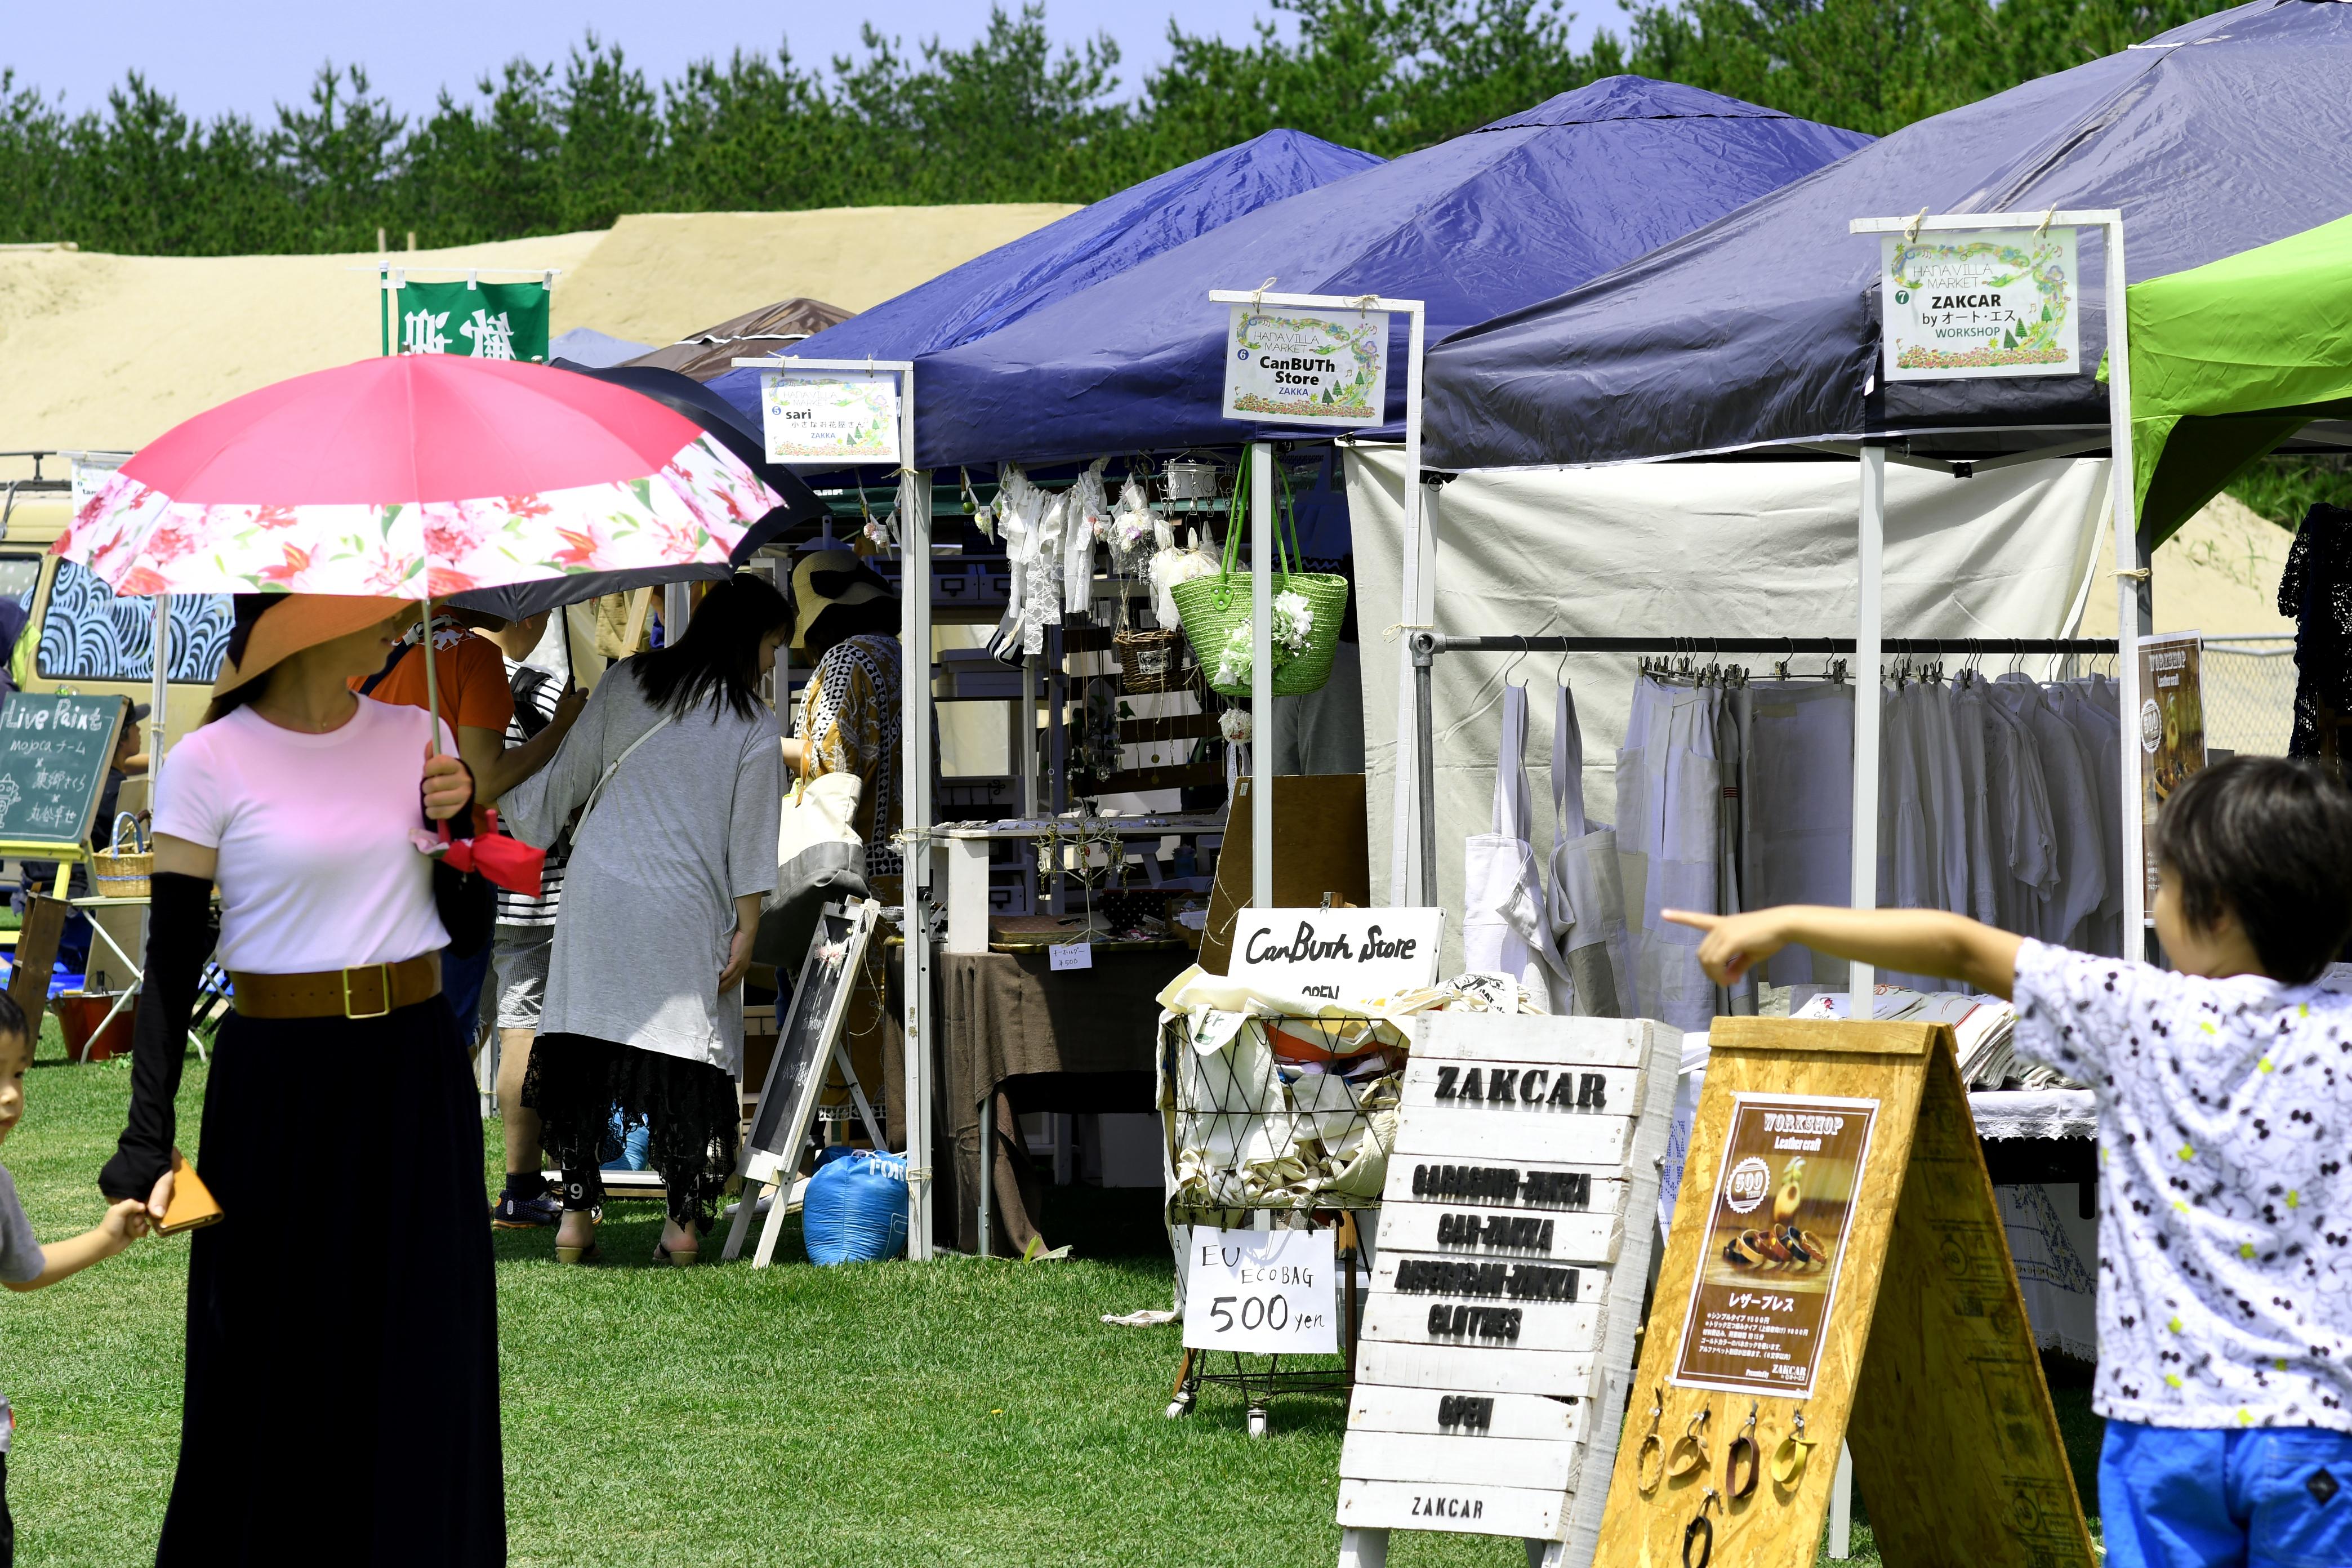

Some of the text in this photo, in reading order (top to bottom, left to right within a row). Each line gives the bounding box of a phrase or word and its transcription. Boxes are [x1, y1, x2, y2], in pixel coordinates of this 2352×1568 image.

[1927, 277, 1979, 289] MARKET
[1932, 293, 2002, 309] ZAKCAR
[1922, 313, 1938, 327] by
[1935, 327, 2001, 338] WORKSHOP
[1264, 342, 1307, 353] MARKET
[1259, 356, 1335, 372] CanBUTh
[1275, 371, 1319, 385] Store
[1279, 387, 1308, 396] ZAKKA
[786, 409, 812, 419] sari
[2149, 651, 2186, 671] WORKSHOP
[5, 698, 103, 732] Live Paint
[1358, 925, 1416, 963] Store
[1435, 1066, 1607, 1108] ZAKCAR
[1763, 1113, 1844, 1135] WORKSHOP
[1735, 1171, 1763, 1193] 500
[1437, 1213, 1554, 1250] CAR-ZAKKA
[1201, 1245, 1240, 1267] EU
[1210, 1294, 1325, 1334] 500 yen
[1428, 1304, 1522, 1339] CLOTHES
[1772, 1364, 1807, 1376] ZAKCAR
[1411, 1497, 1483, 1519] ZAKCAR
